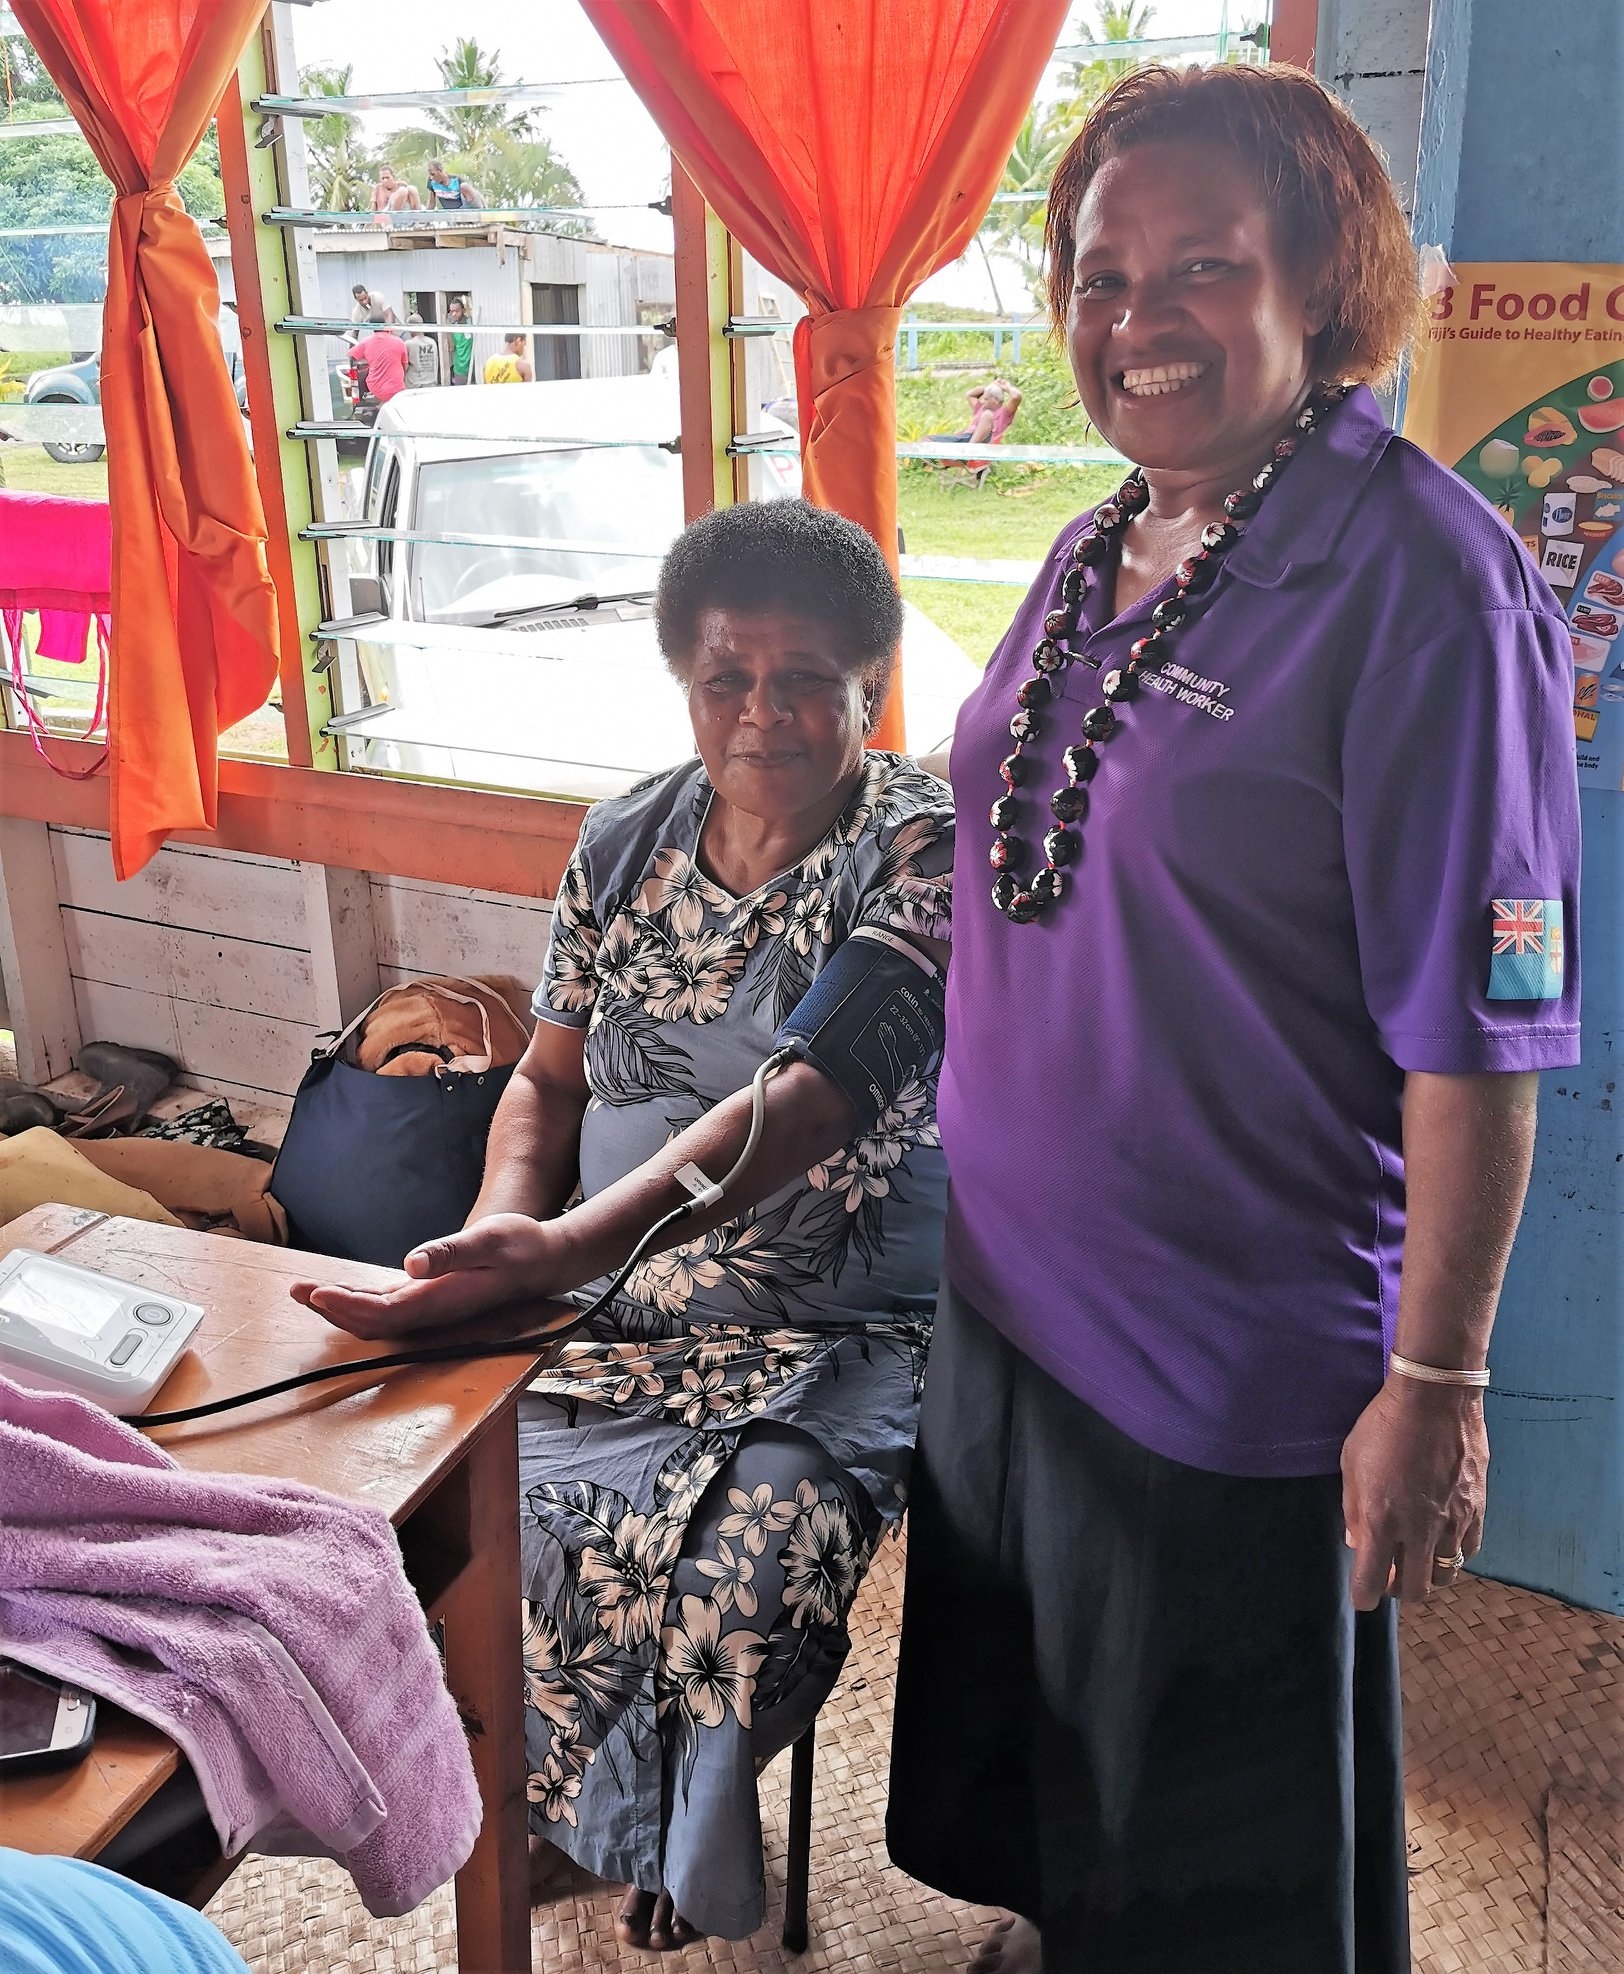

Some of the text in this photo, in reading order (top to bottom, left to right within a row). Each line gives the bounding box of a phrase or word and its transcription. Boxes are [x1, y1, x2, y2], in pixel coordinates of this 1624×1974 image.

[1431, 286, 1454, 321] 3
[1469, 282, 1591, 321] Food
[1459, 327, 1501, 340] Guide
[1505, 329, 1520, 340] to
[1524, 328, 1581, 343] Healthy
[1584, 328, 1624, 343] Eatin
[1546, 551, 1577, 570] RICE
[1160, 661, 1231, 698] COMMUNITY
[1138, 670, 1235, 721] HEALTH WORKER
[872, 930, 895, 943] RANGE
